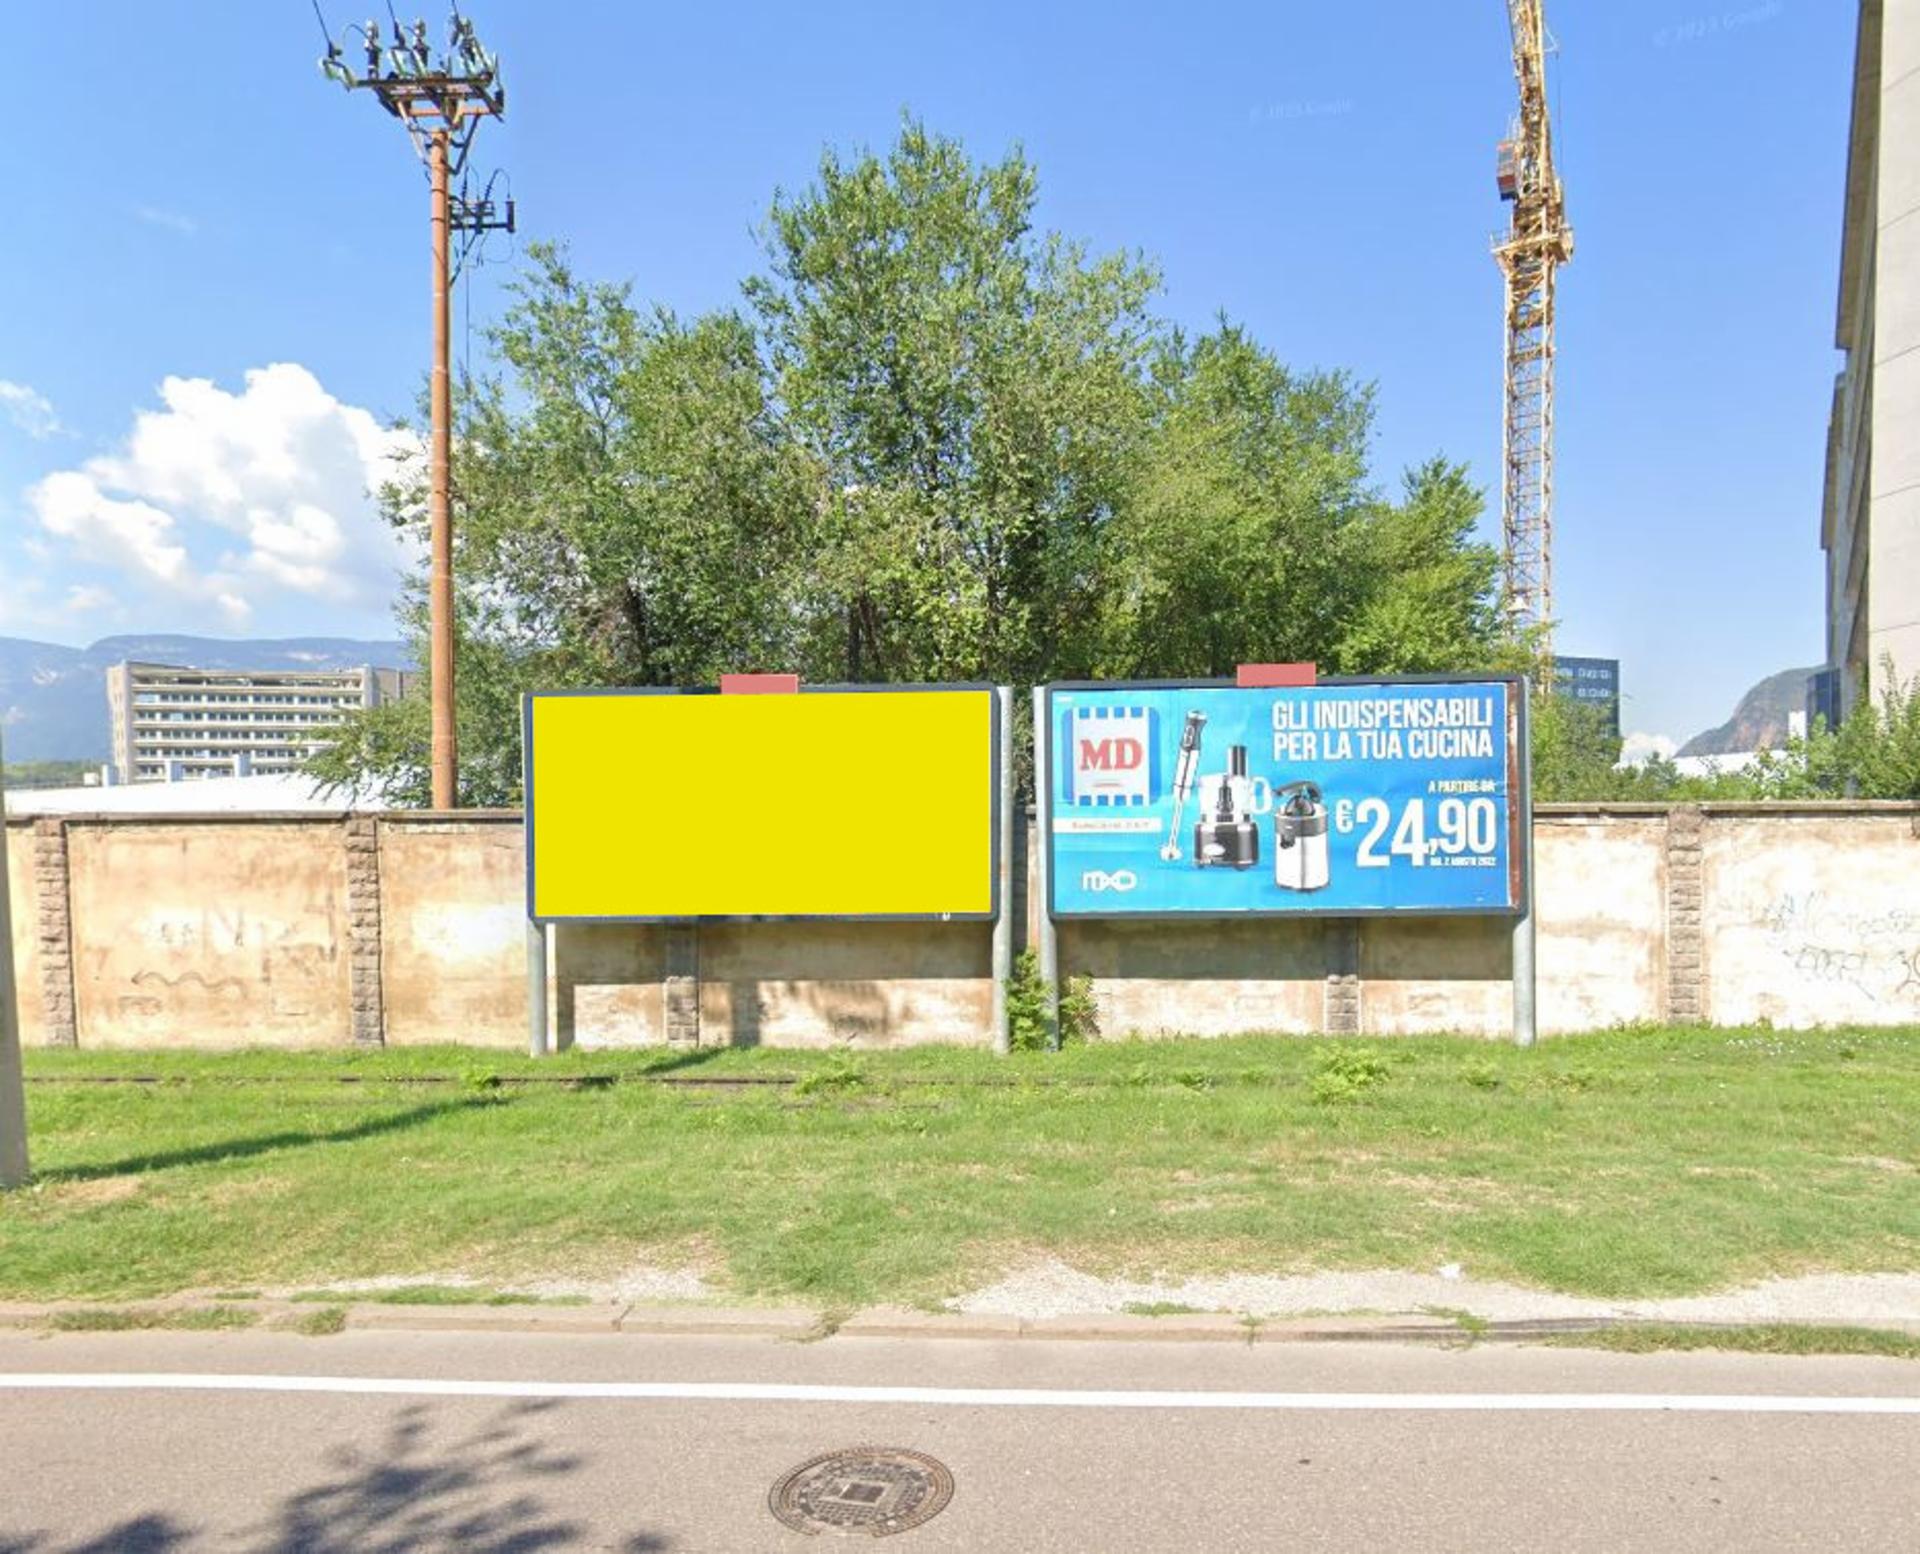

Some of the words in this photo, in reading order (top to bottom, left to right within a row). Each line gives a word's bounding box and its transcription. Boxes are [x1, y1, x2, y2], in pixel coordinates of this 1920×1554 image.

[1272, 701, 1308, 730] GLI
[1314, 697, 1493, 728] INDISPENSABILI
[1079, 737, 1144, 771] MD
[1274, 732, 1316, 761] PER
[1323, 731, 1352, 760] LA
[1357, 730, 1403, 759] TUA
[1408, 728, 1494, 759] CUCINA
